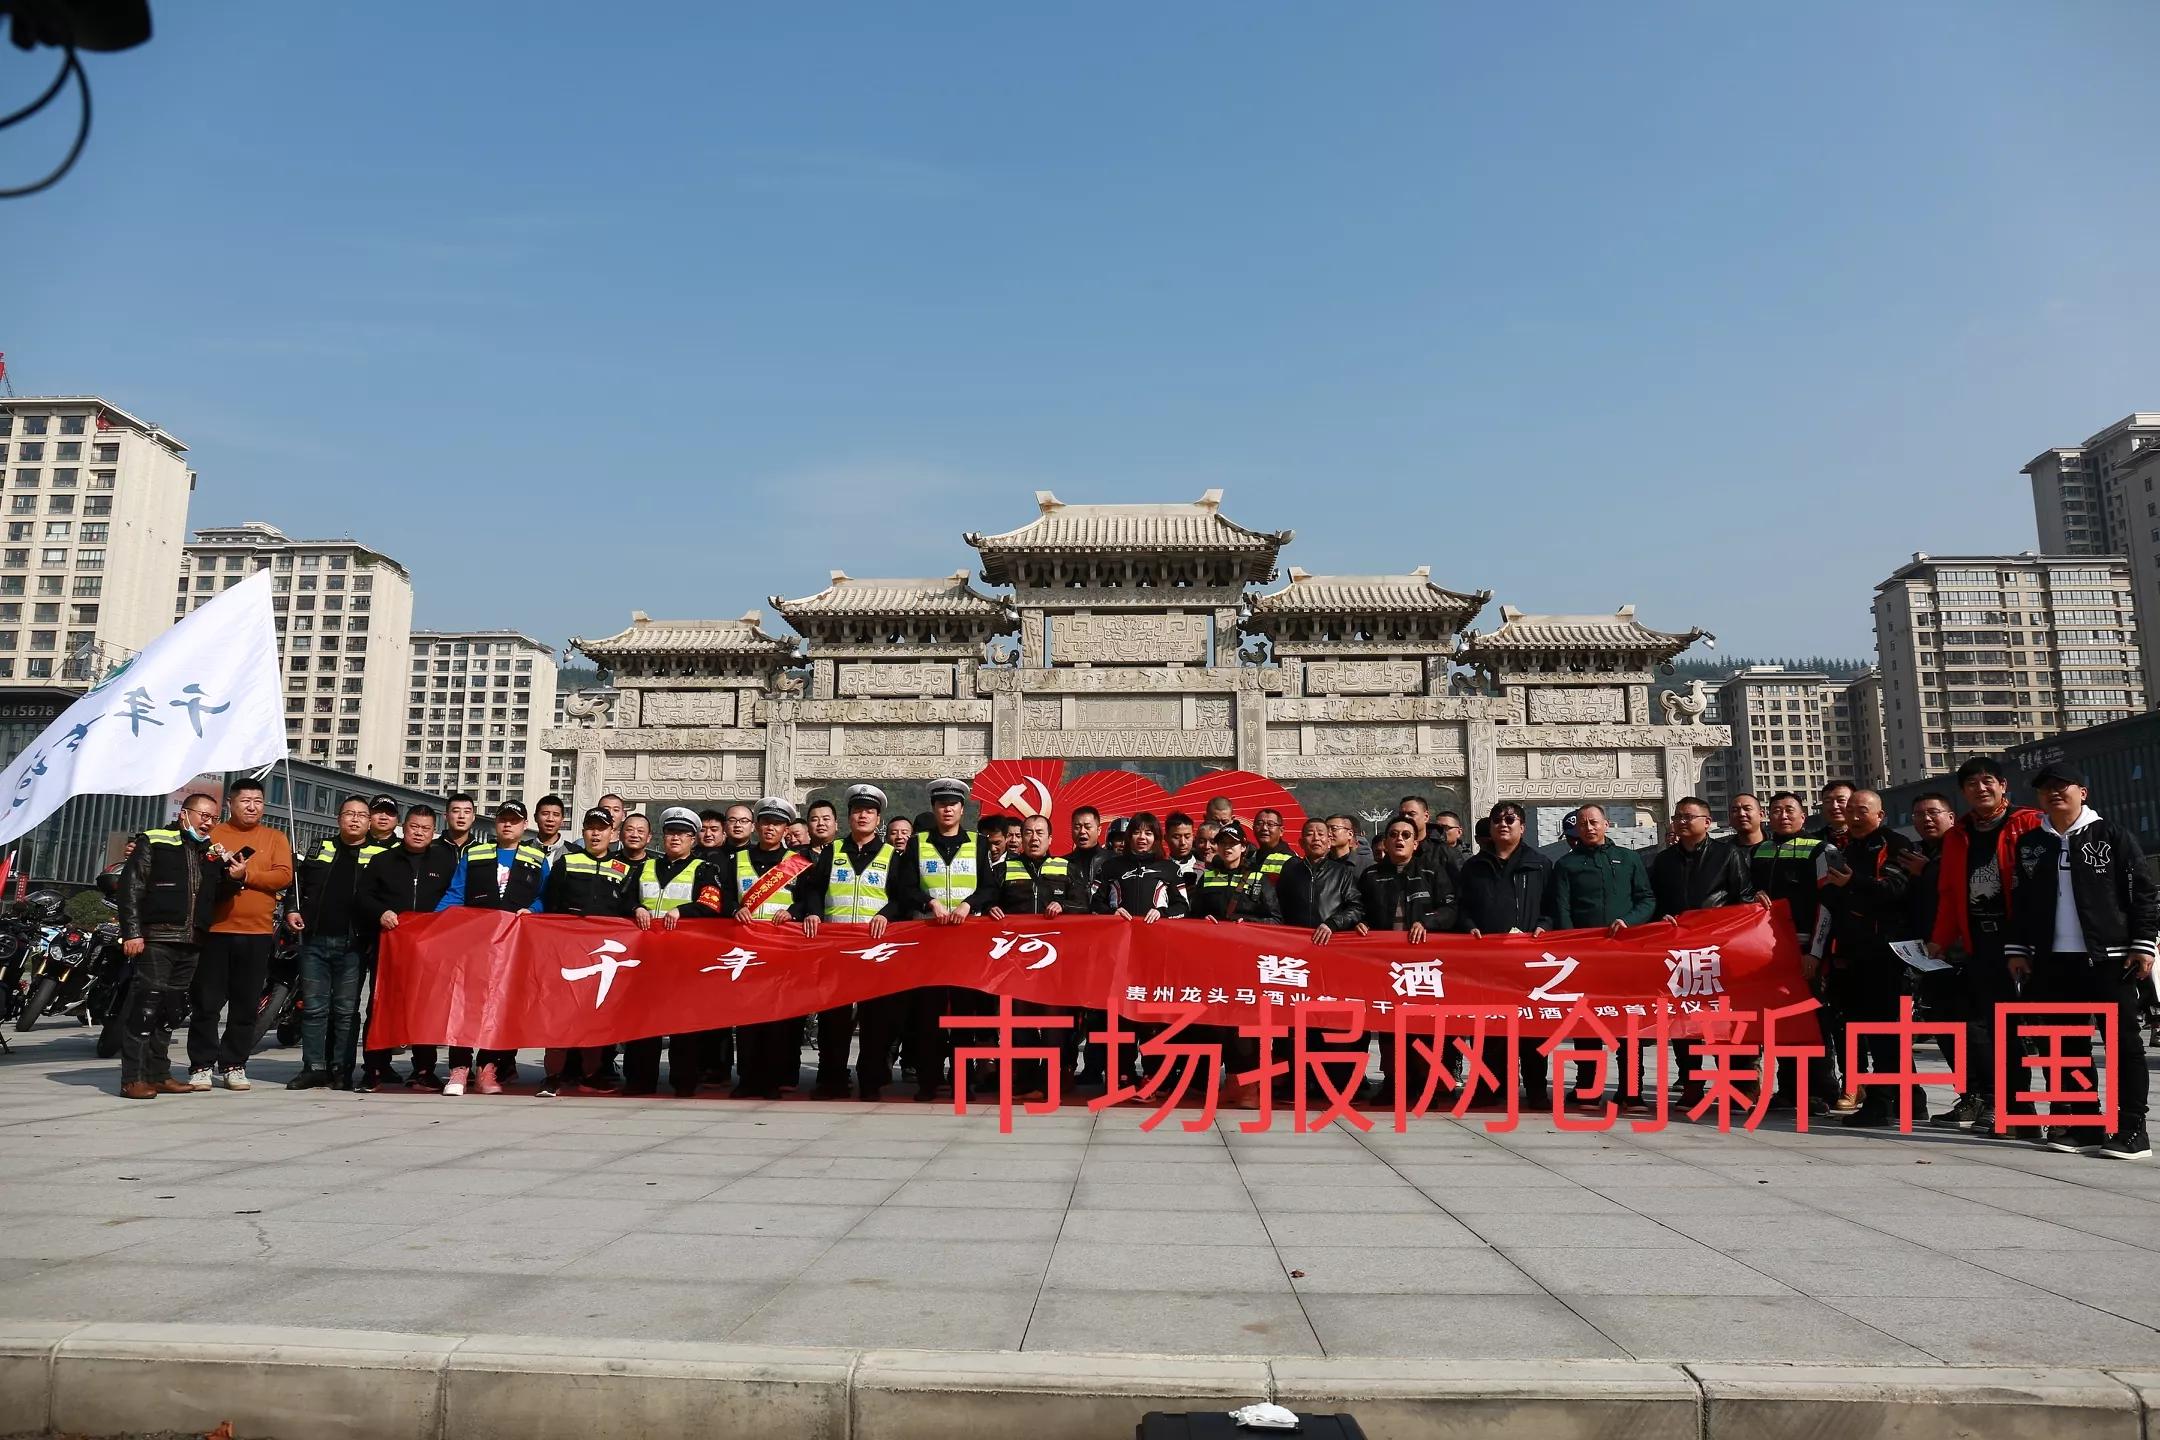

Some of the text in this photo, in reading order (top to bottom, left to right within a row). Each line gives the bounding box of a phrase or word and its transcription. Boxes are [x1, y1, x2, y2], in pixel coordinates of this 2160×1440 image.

[0, 705, 54, 717] 615678
[2081, 841, 2111, 867] NY
[1256, 943, 1724, 1003] 酱酒之源
